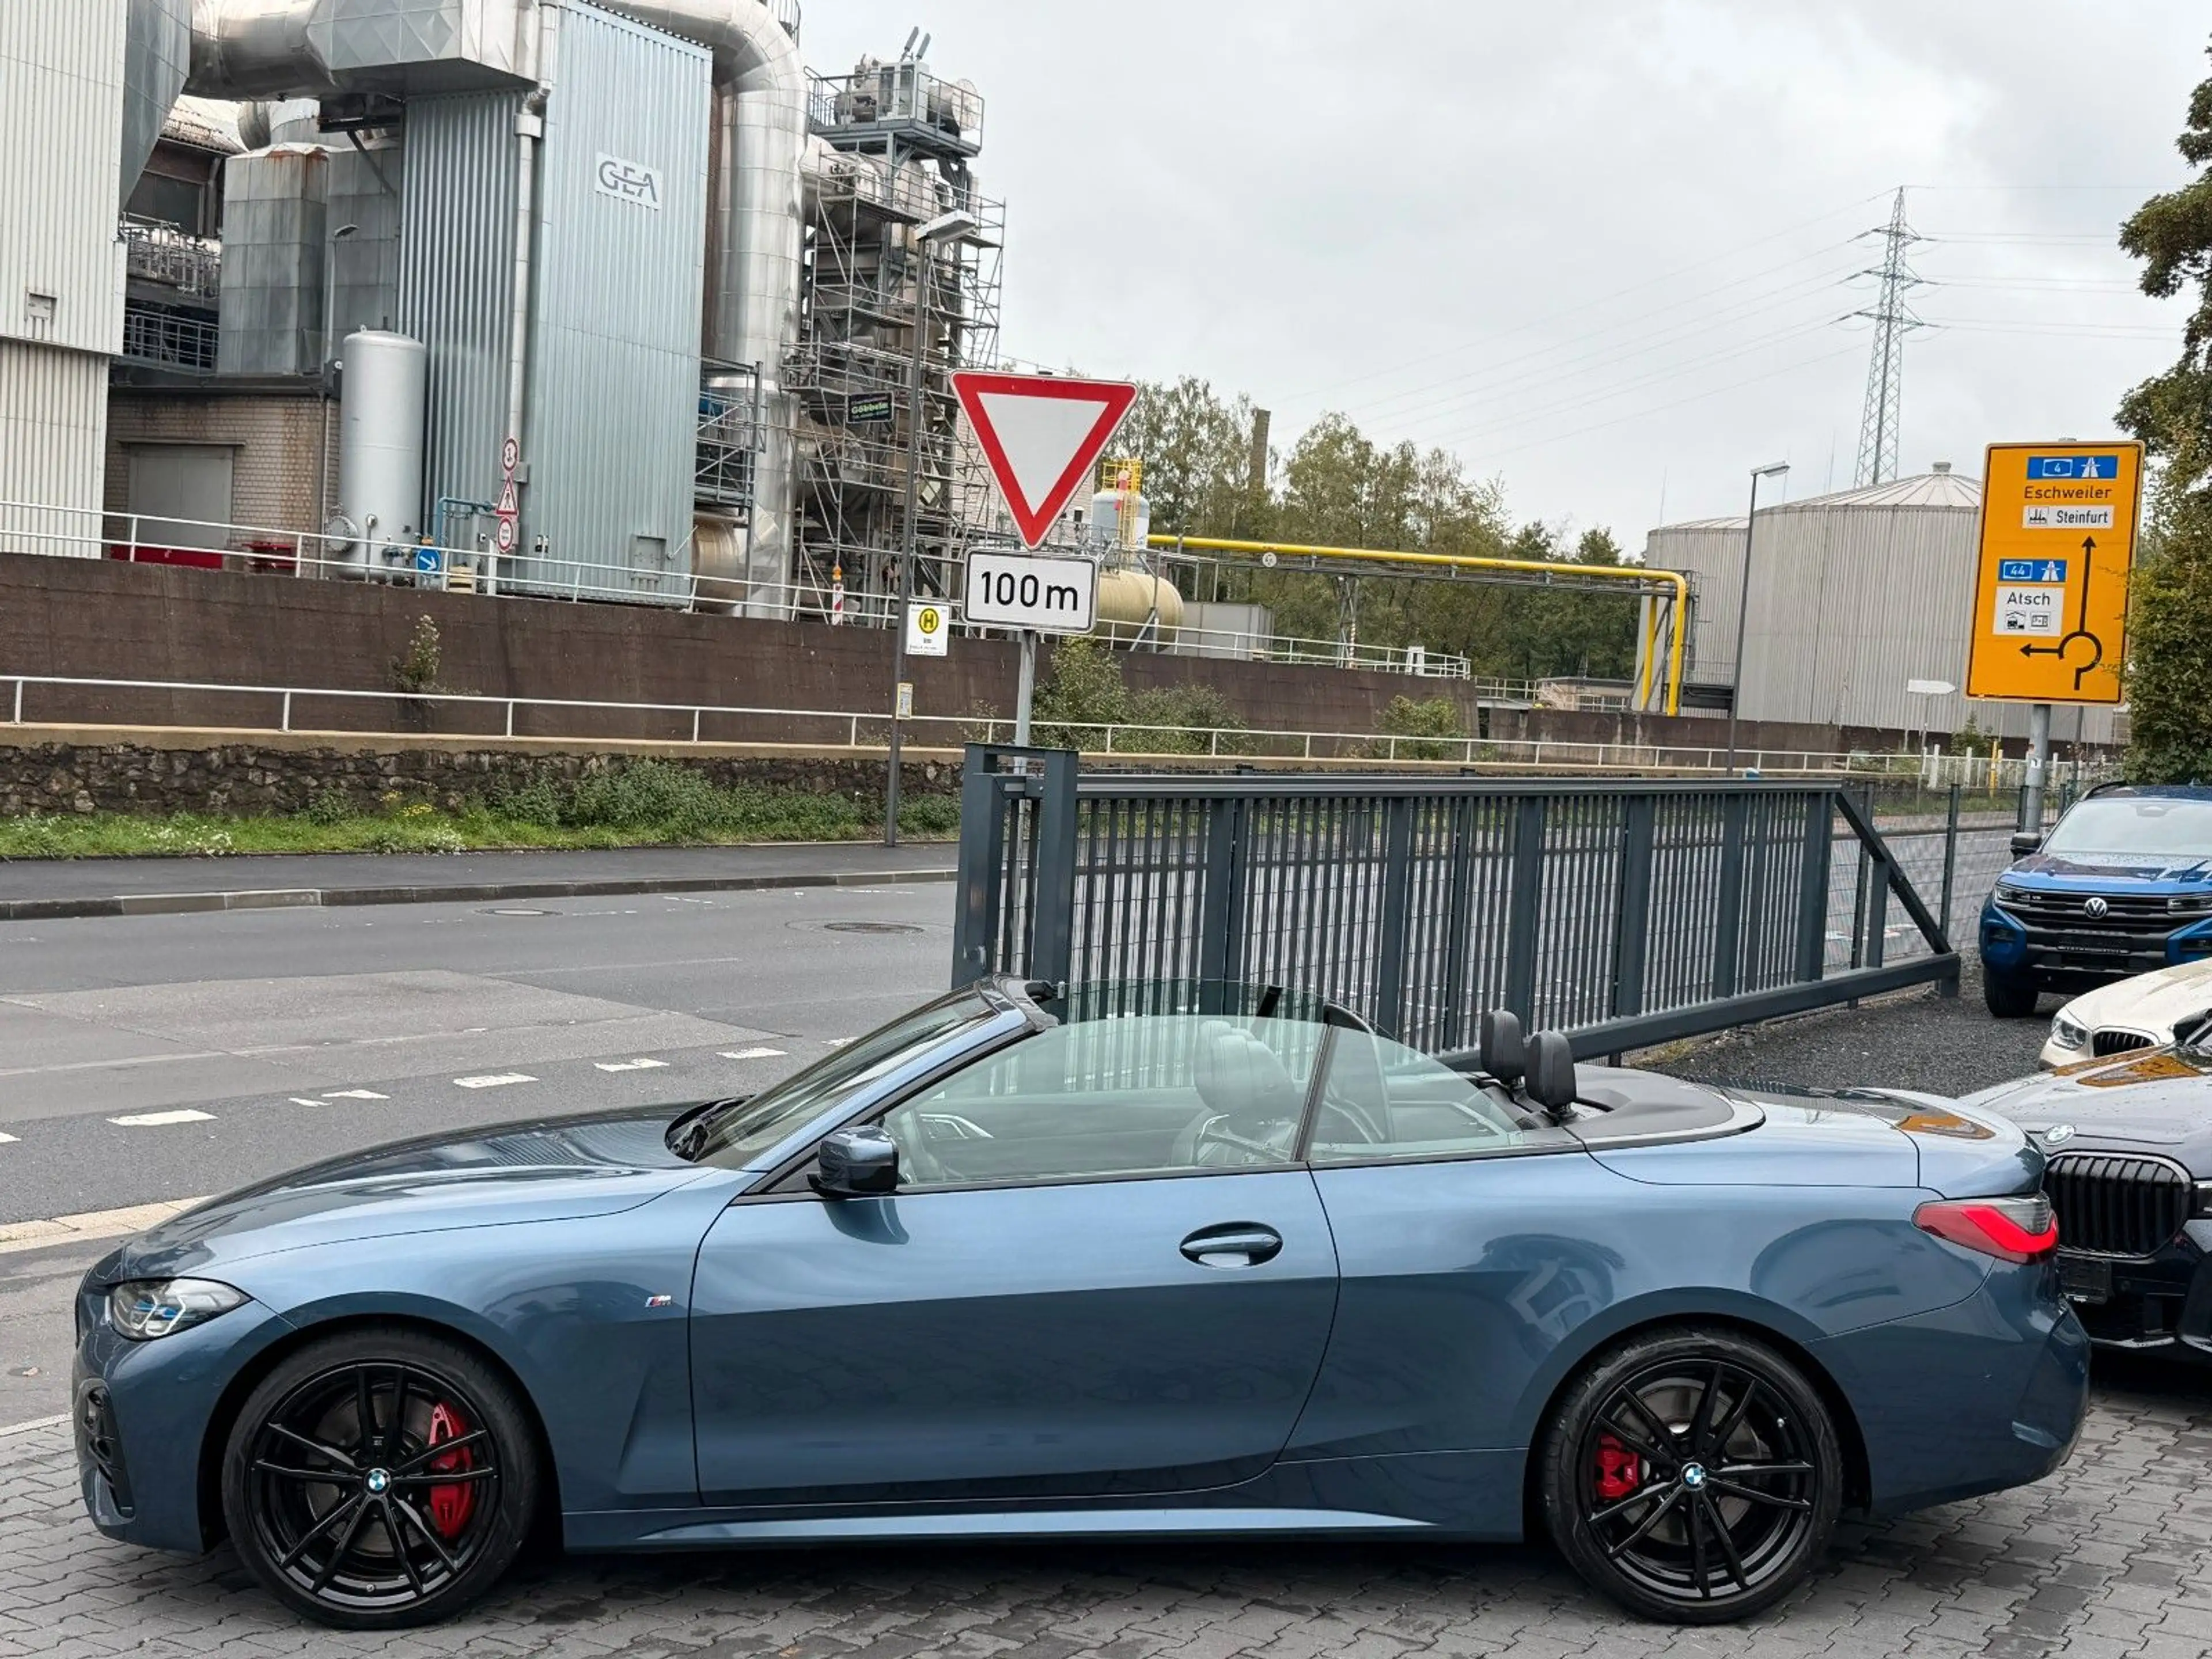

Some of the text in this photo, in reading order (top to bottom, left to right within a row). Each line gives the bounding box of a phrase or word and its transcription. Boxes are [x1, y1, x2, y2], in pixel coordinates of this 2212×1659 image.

[599, 161, 657, 202] GEA
[2054, 463, 2061, 473] 4
[2024, 486, 2112, 498] Eschweiler
[2056, 510, 2108, 524] Steinfurt
[2010, 566, 2025, 575] 44
[2007, 592, 2050, 605] Atsch
[923, 613, 934, 628] H
